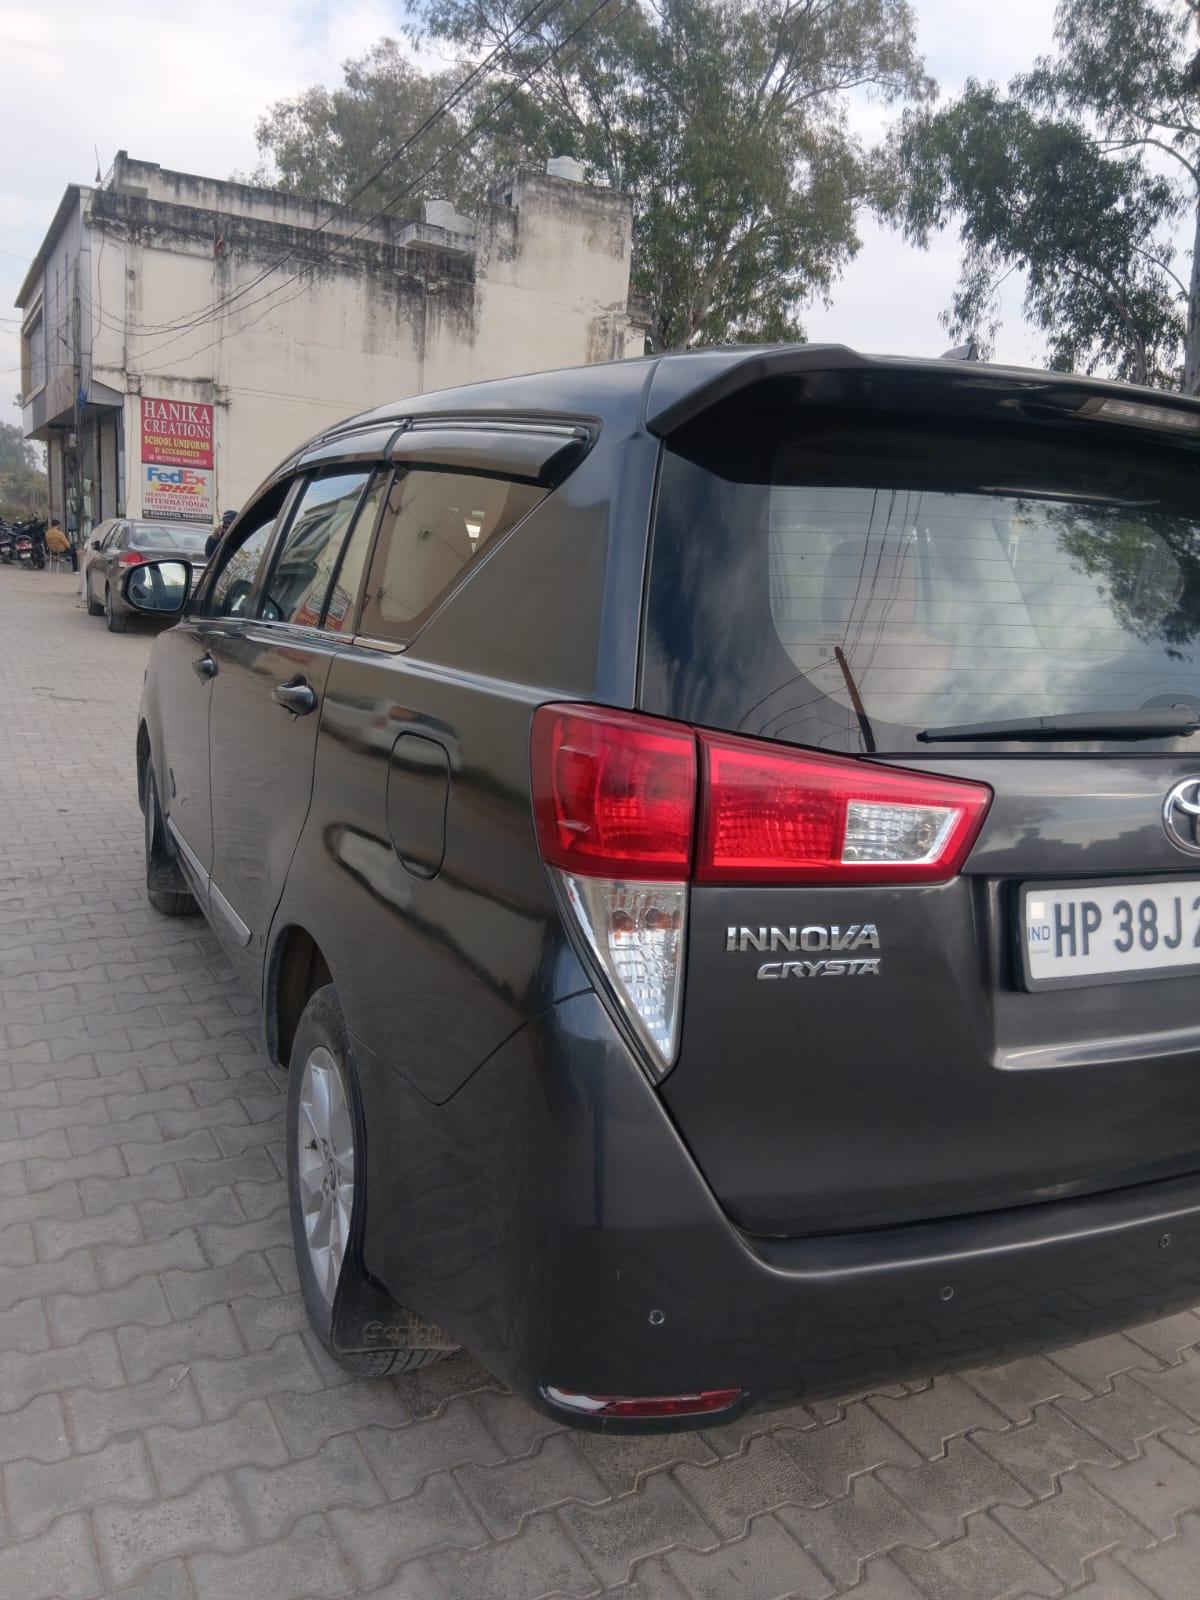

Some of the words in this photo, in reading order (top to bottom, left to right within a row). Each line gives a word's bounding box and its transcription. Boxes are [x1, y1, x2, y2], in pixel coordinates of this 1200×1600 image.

[144, 400, 211, 424] HANIKA
[144, 418, 211, 439] CREATIONS
[144, 435, 173, 447] SCHOOL
[173, 438, 210, 451] UNIFORMS
[147, 467, 208, 486] FedEx
[157, 484, 199, 495] DHL
[167, 493, 199, 502] DISCOUNT
[145, 497, 209, 509] INTERNATIONAL
[726, 924, 880, 951] INNOVA
[1028, 926, 1050, 941] IND
[1054, 901, 1102, 957] HP
[756, 958, 881, 980] CRYSTA
